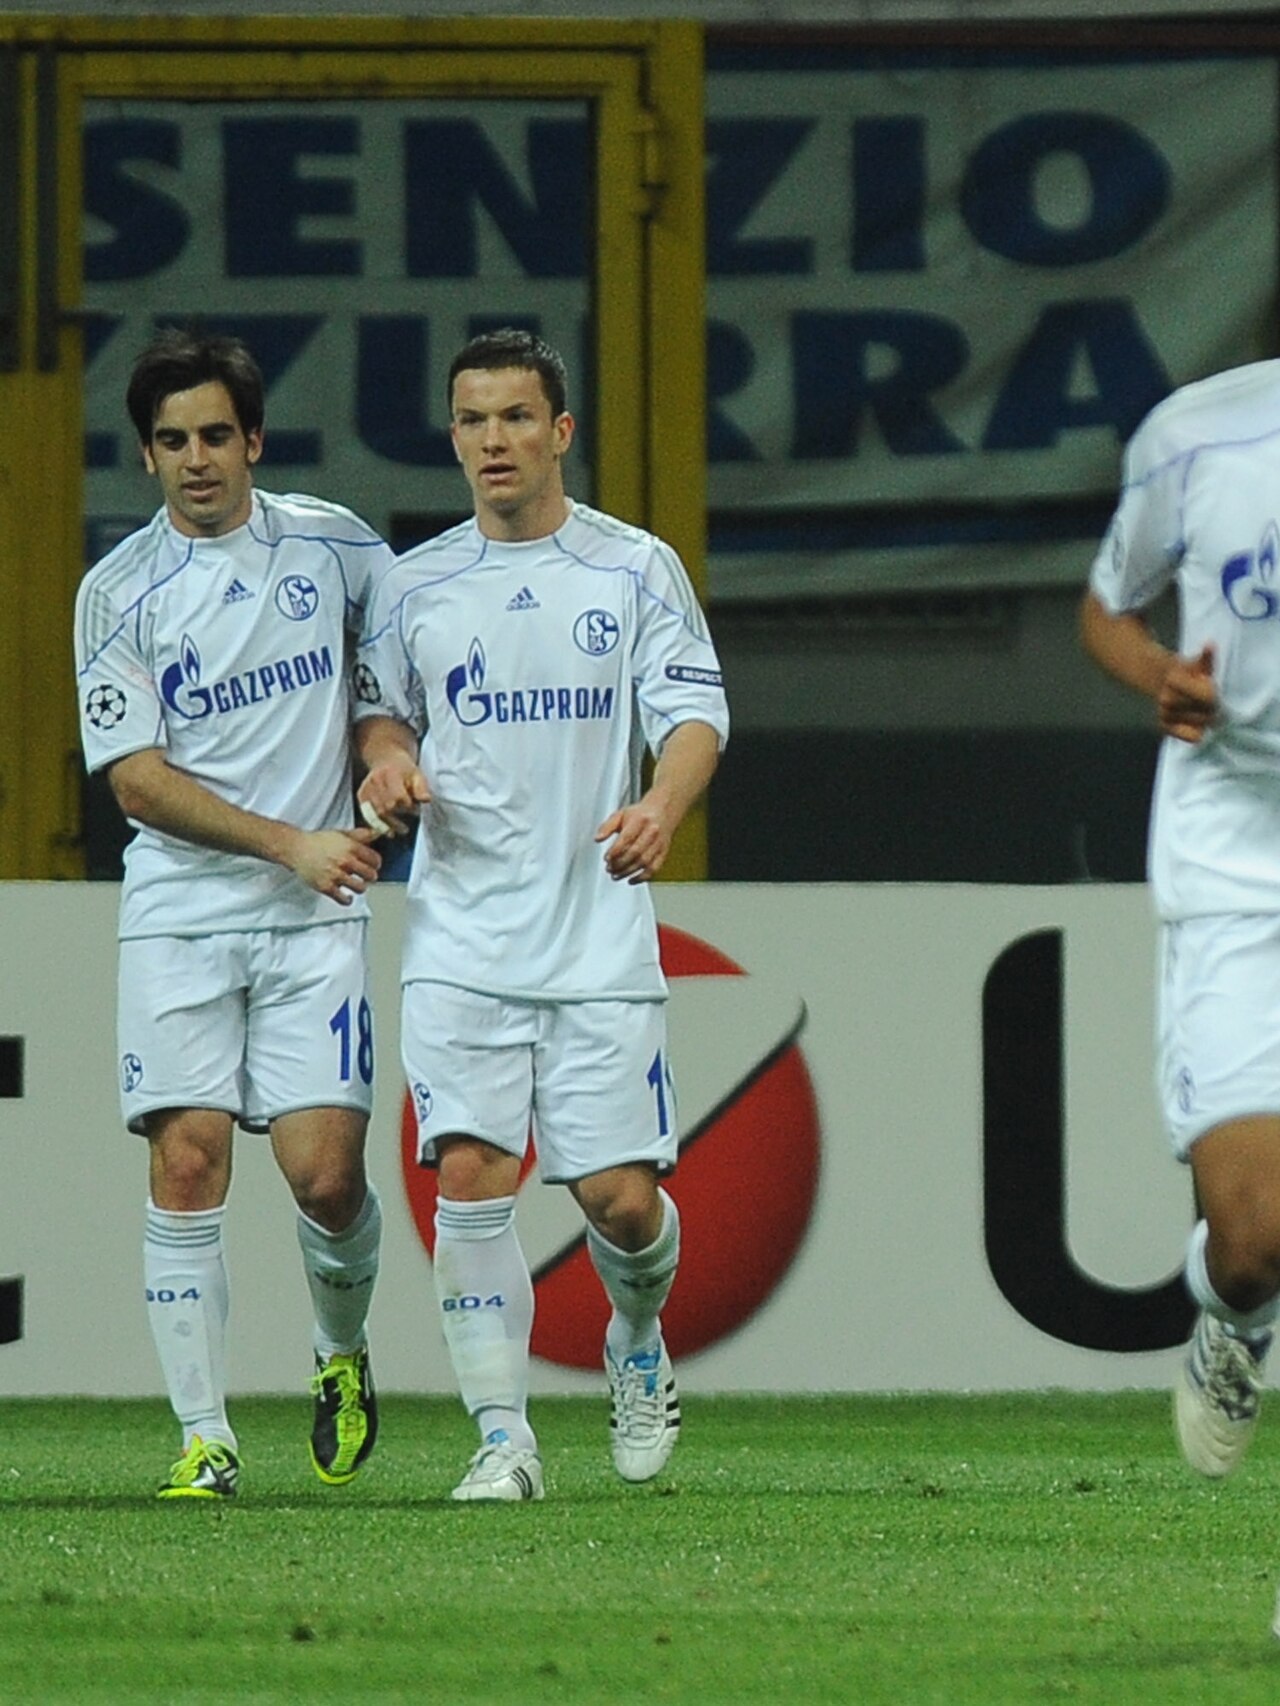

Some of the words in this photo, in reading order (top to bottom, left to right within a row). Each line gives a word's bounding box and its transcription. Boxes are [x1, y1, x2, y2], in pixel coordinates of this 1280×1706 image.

[212, 645, 333, 713] GAZPROM
[494, 687, 614, 723] GAZPROM
[329, 996, 374, 1085] 18
[647, 1048, 671, 1137] 1
